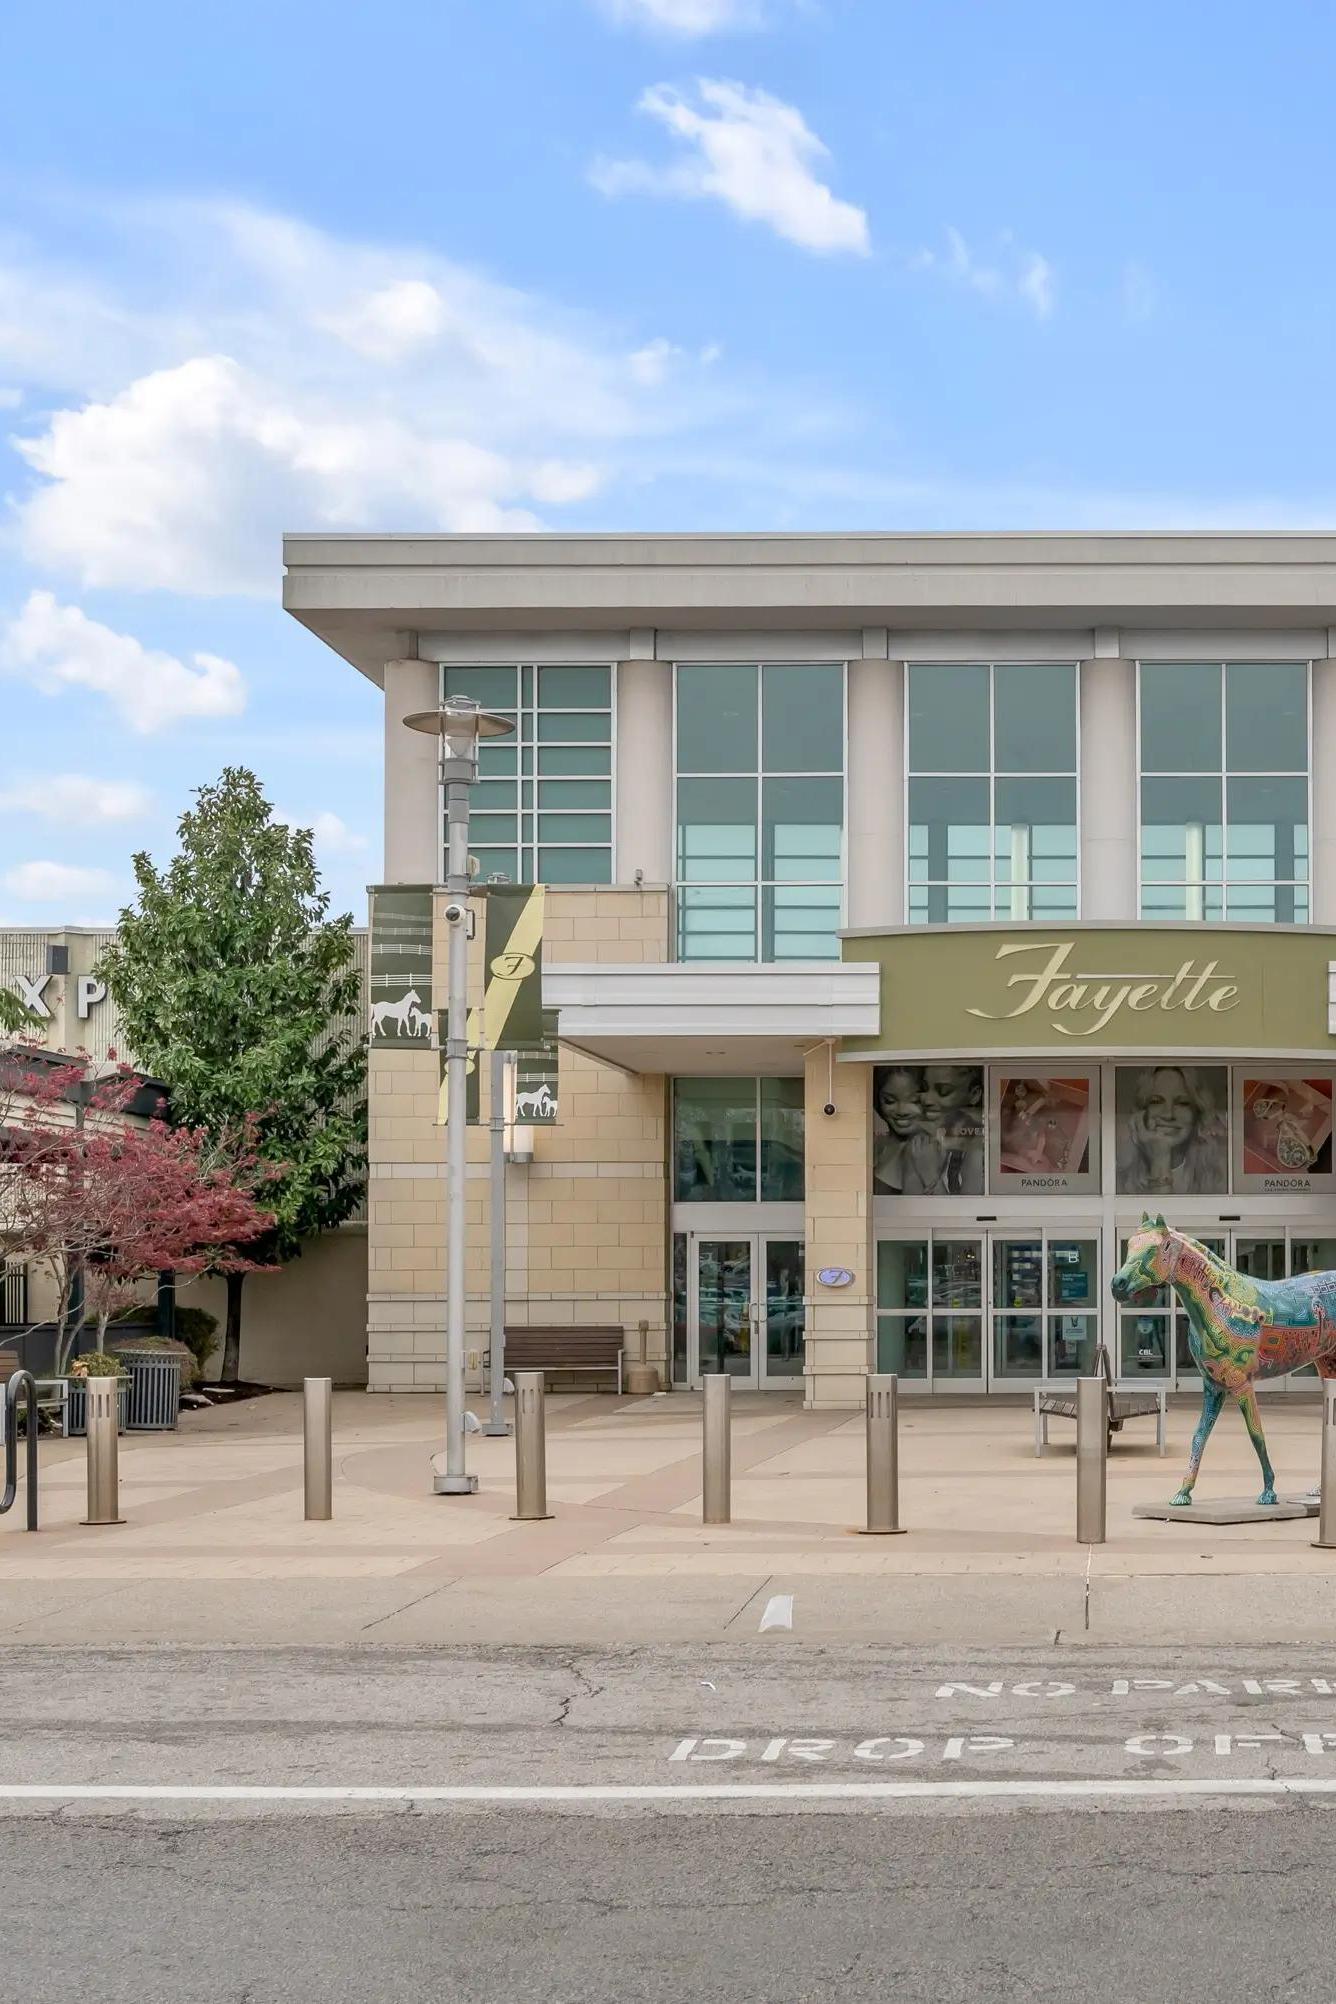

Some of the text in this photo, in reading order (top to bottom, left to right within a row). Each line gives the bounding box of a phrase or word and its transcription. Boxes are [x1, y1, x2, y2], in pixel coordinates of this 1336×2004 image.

[965, 942, 1241, 1036] Fayette
[1021, 1178, 1069, 1187] PANDORA
[1264, 1179, 1312, 1188] PANDORA
[1138, 1348, 1153, 1356] CBL
[935, 1681, 1077, 1698] NO
[668, 1736, 1016, 1762] DROP
